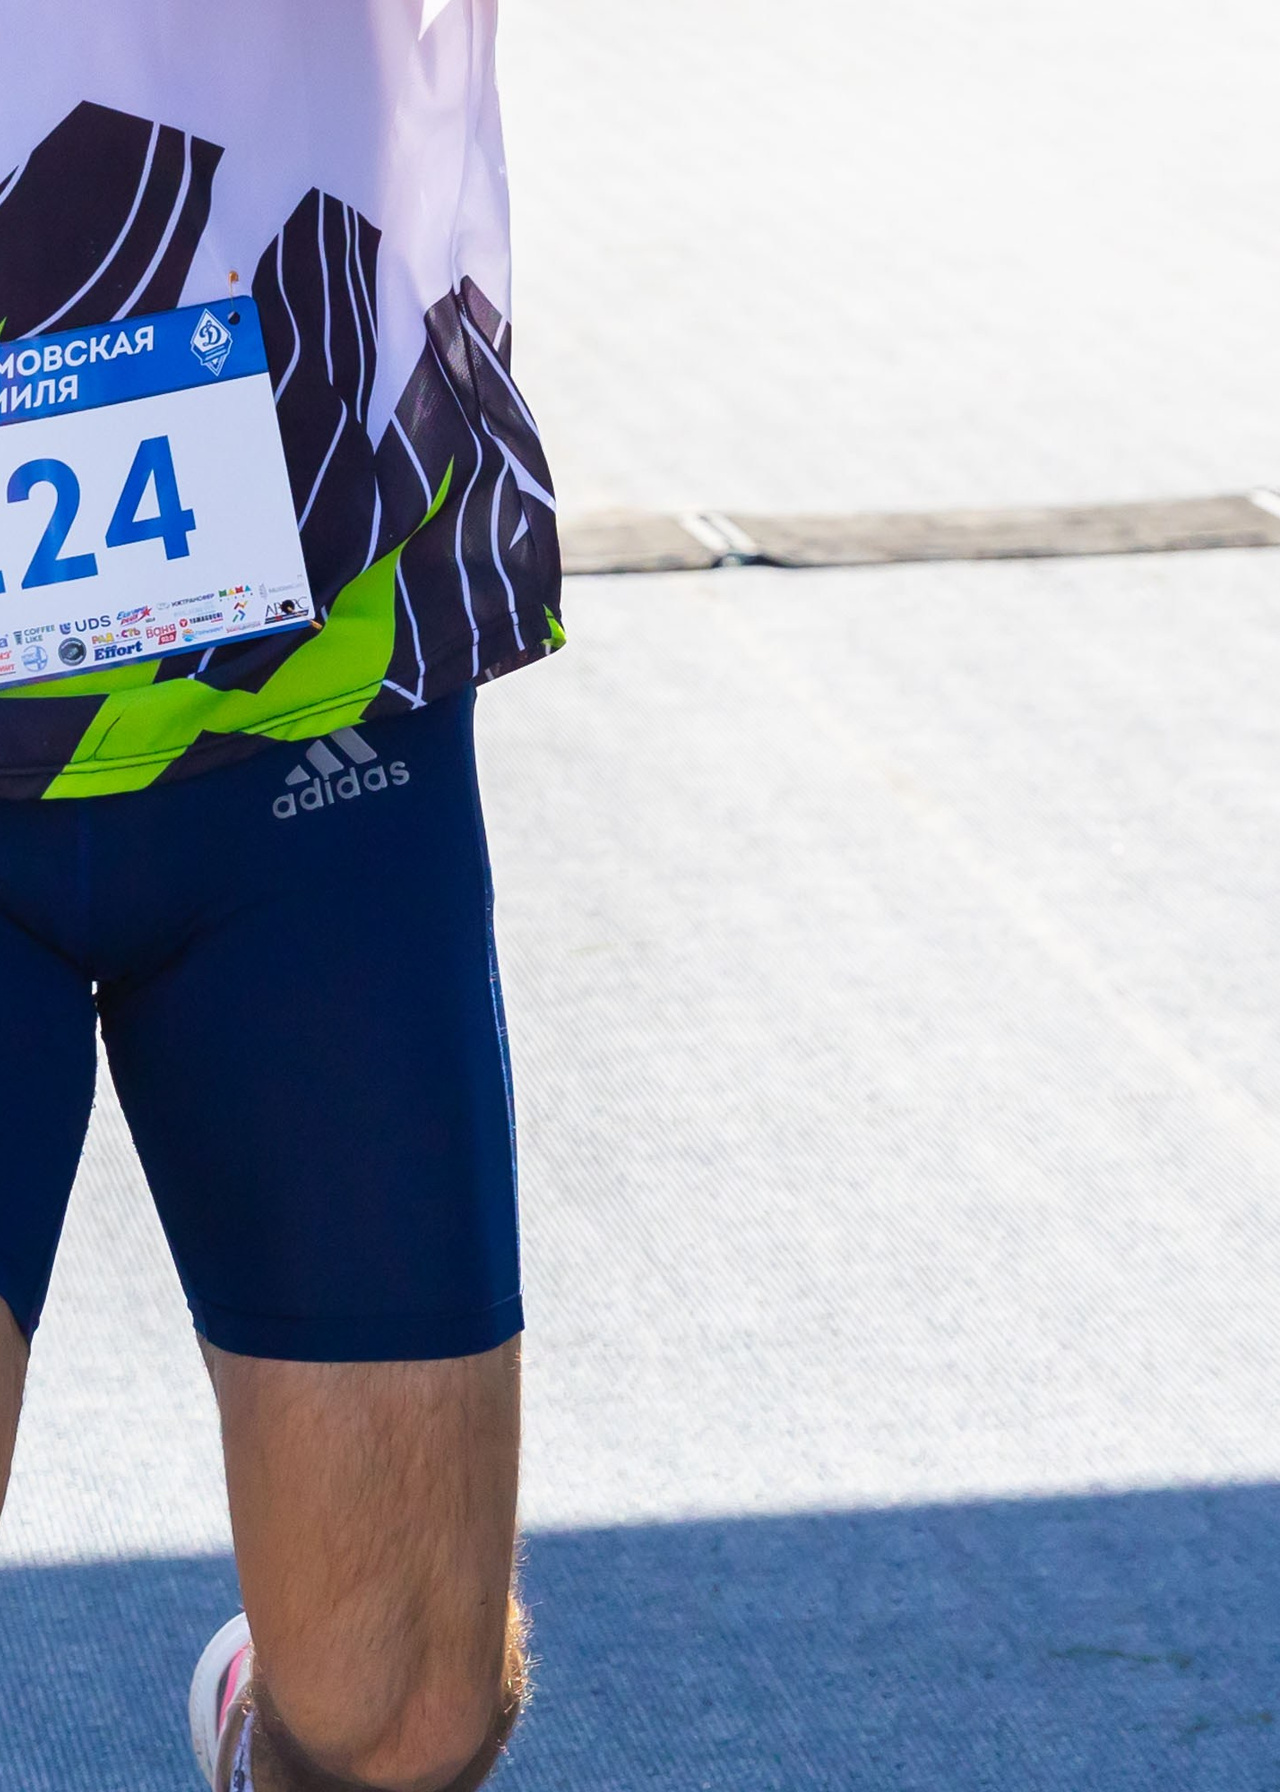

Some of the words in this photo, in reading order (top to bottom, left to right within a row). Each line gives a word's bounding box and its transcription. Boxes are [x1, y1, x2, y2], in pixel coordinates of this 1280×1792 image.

[23, 624, 55, 636] COFFEE
[75, 615, 112, 632] UDS
[24, 635, 43, 644] LIKE
[93, 640, 144, 661] Effort
[272, 761, 410, 819] adidas
